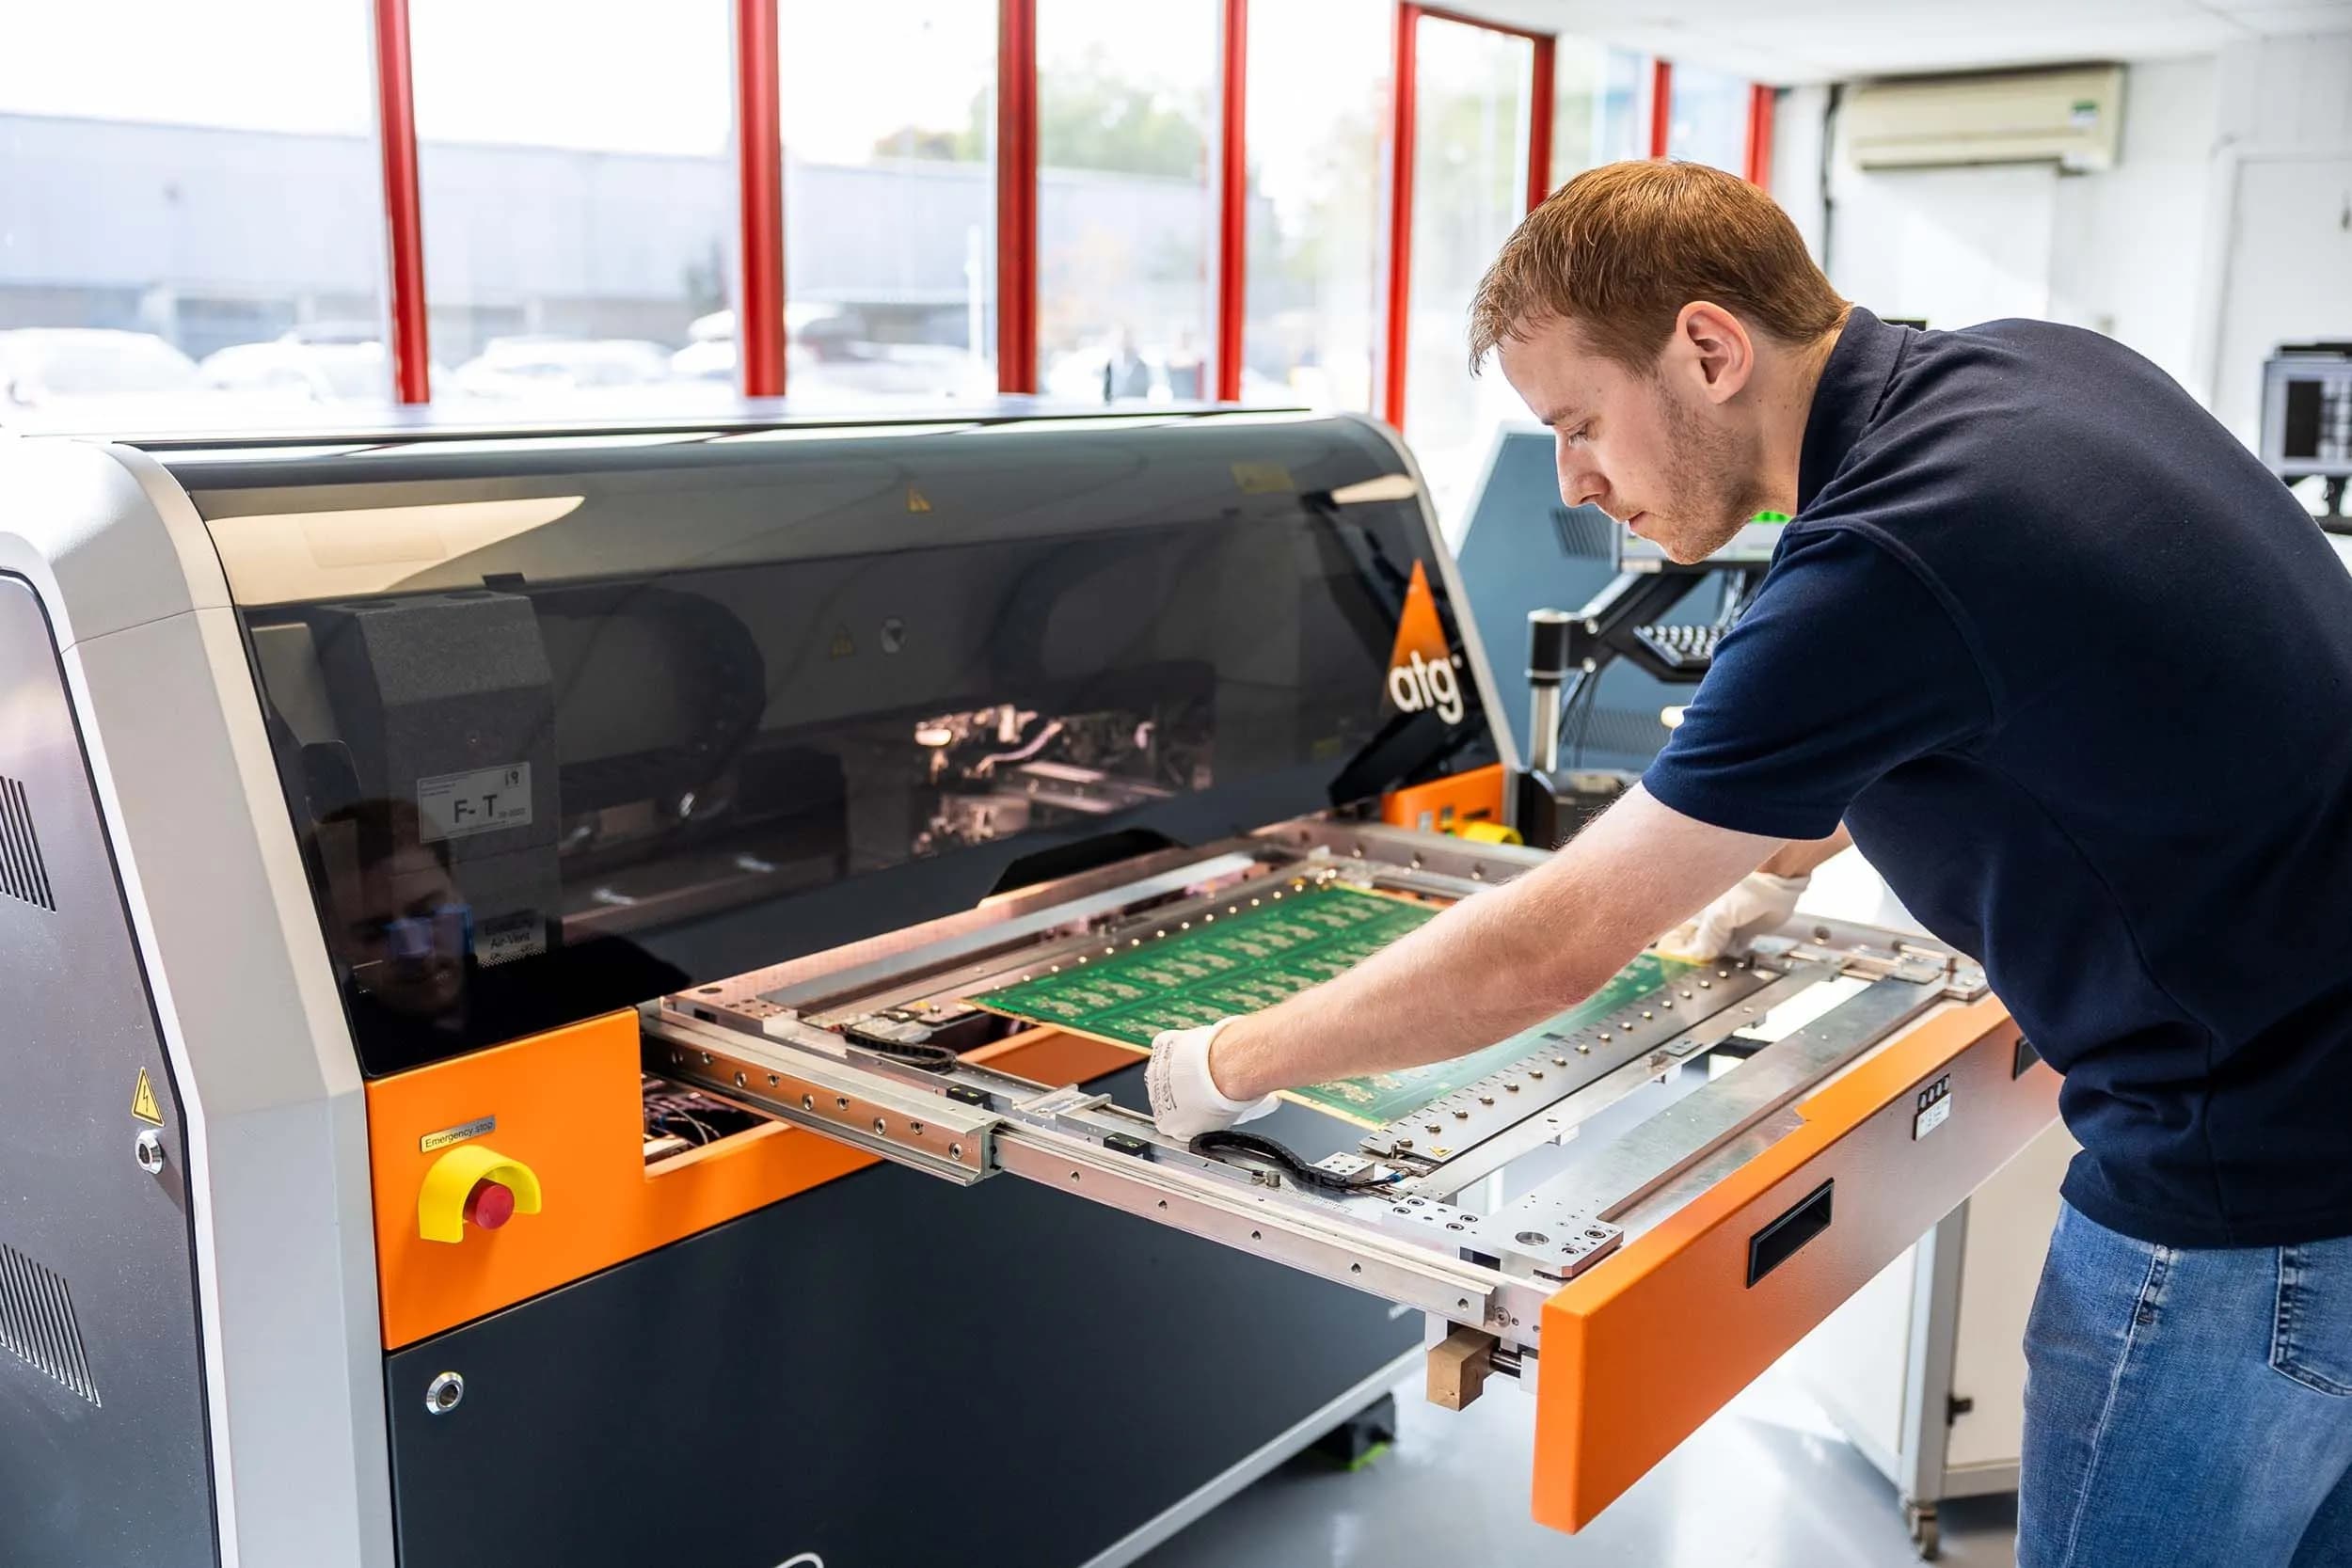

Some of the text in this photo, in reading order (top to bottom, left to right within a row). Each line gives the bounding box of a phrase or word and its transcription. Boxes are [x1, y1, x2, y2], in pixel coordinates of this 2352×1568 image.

[1388, 650, 1464, 725] atg
[425, 1120, 494, 1148] Emergency stop
